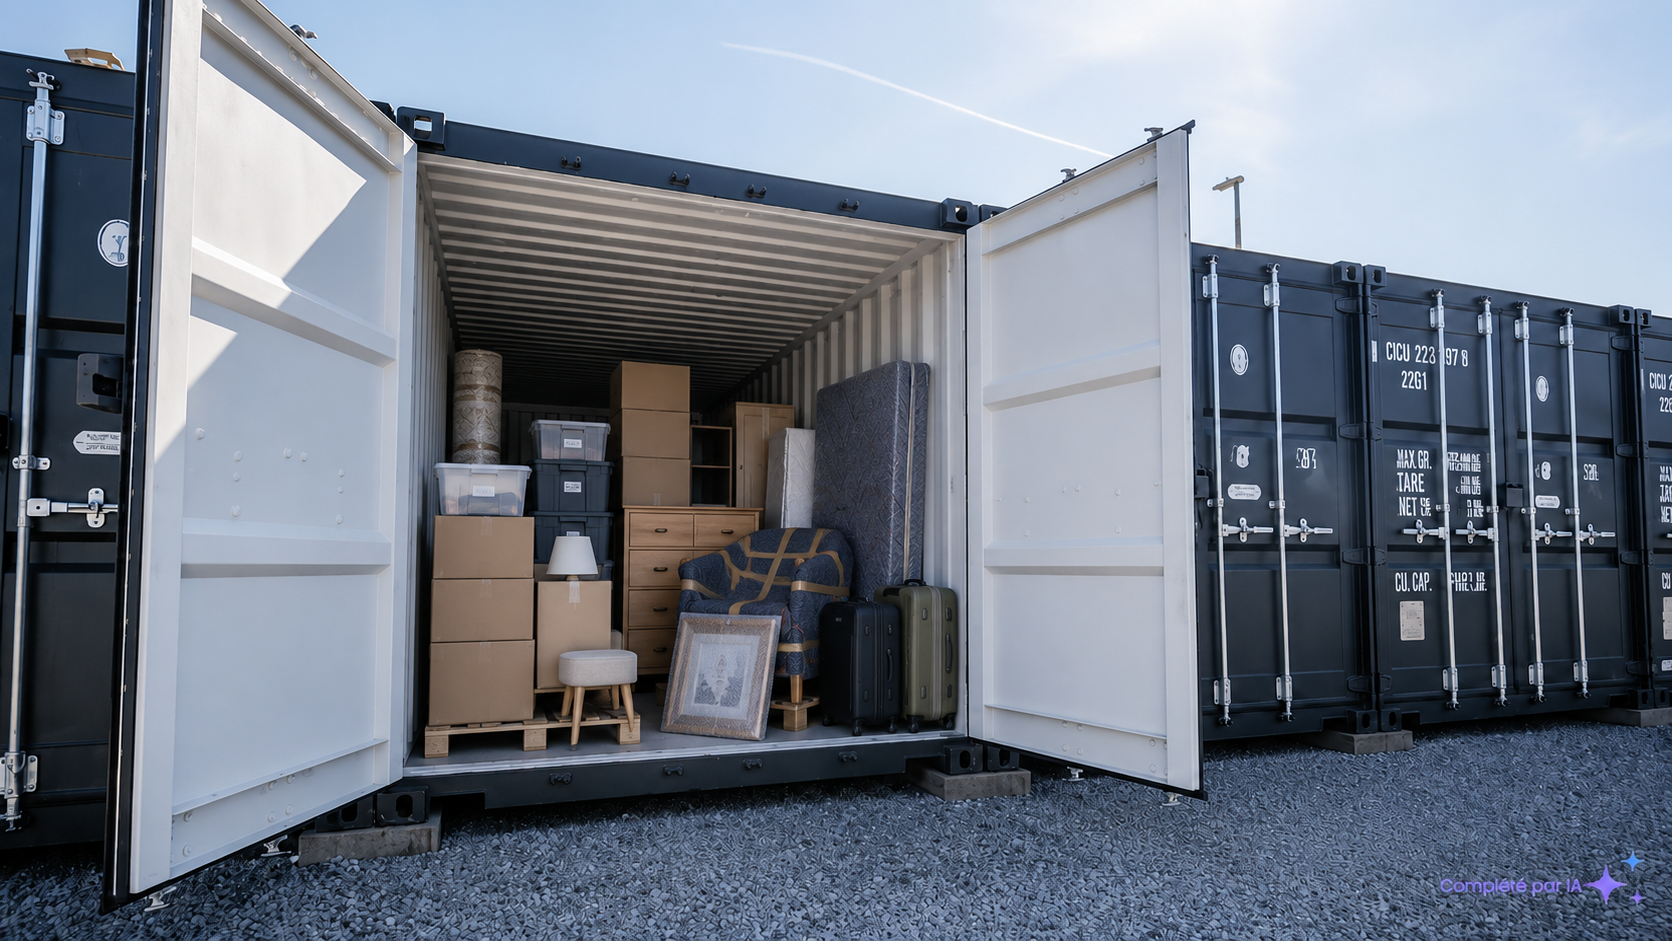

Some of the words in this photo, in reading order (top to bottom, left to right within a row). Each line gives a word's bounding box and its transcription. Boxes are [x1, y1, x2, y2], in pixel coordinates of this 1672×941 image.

[1386, 341, 1410, 362] CICU
[1401, 370, 1427, 390] 22G1
[1417, 450, 1432, 469] GR.
[1396, 472, 1425, 493] TARE
[1399, 496, 1418, 516] NET
[1395, 572, 1410, 592] CU.
[1412, 572, 1433, 592] CAP.
